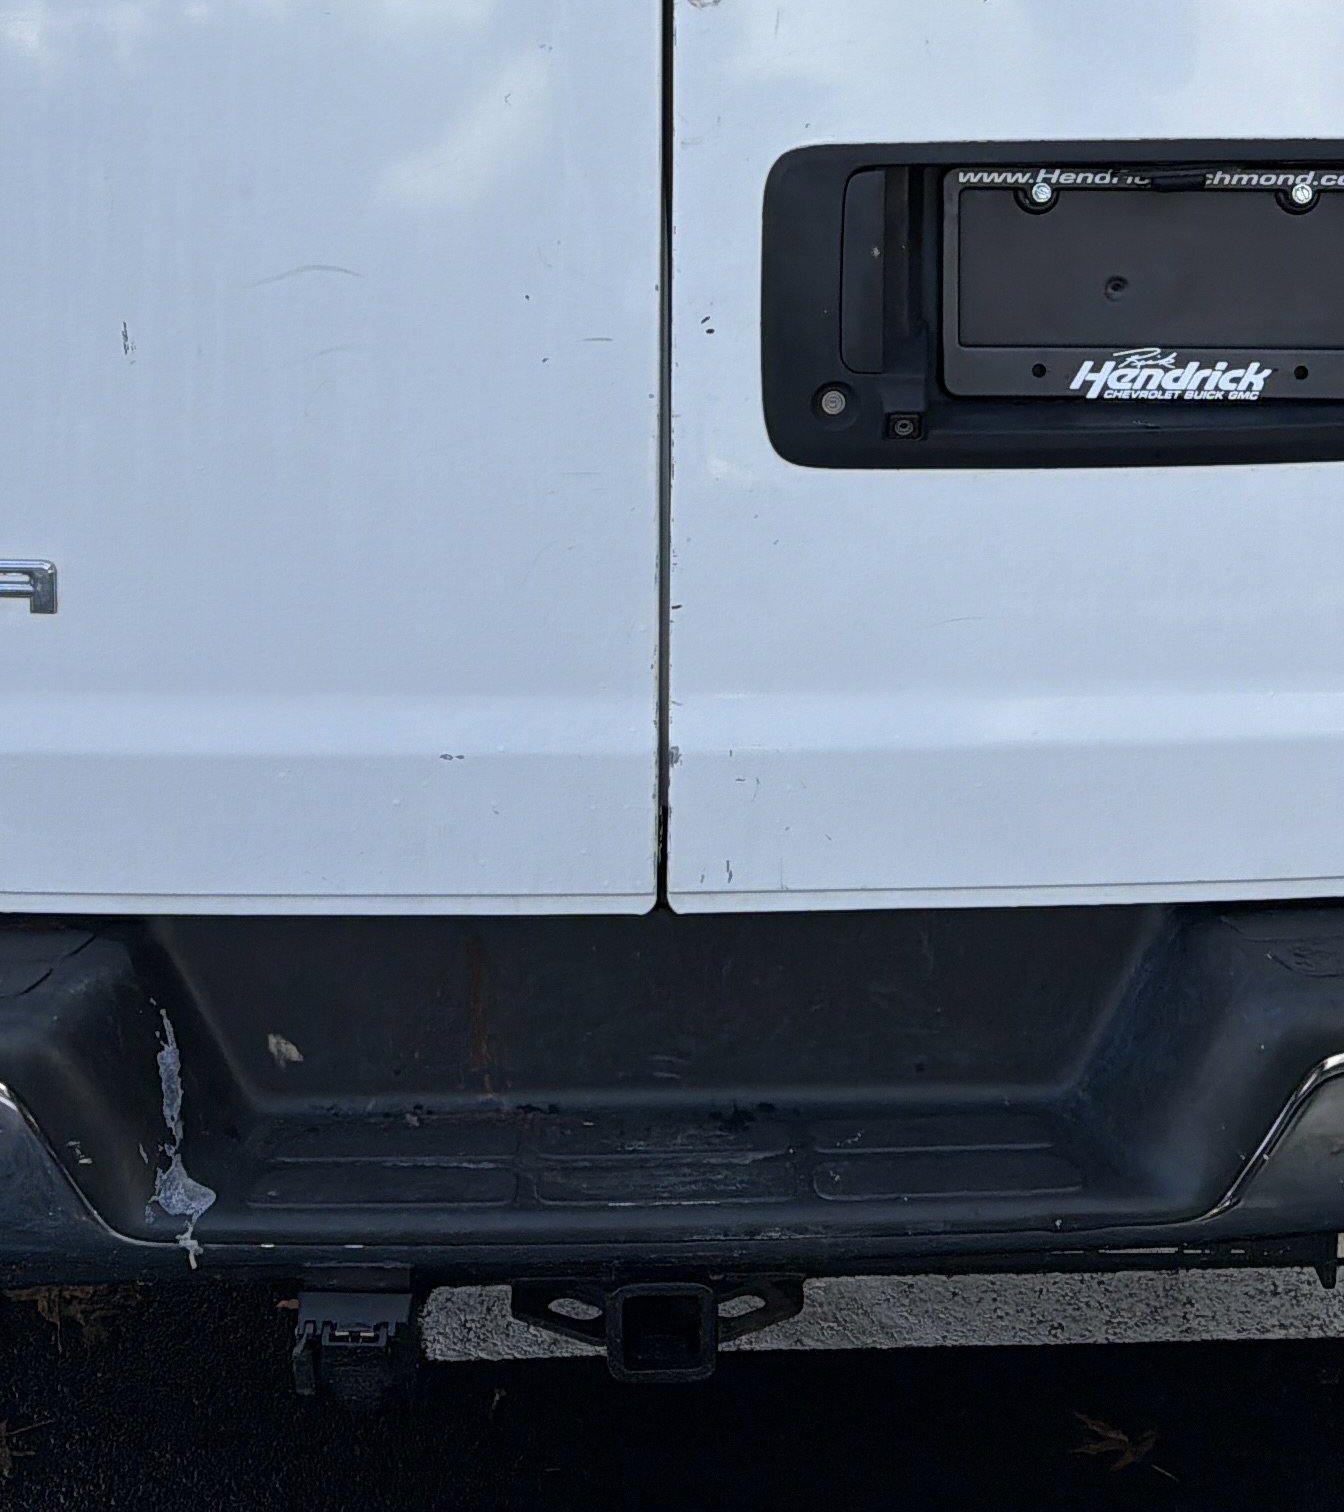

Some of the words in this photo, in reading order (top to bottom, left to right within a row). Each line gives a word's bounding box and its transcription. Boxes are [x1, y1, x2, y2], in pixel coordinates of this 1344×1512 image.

[1069, 360, 1272, 399] Hendrick
[1103, 390, 1182, 400] CHEVROLET
[1186, 390, 1225, 400] BUICK
[1227, 391, 1260, 401] GMC
